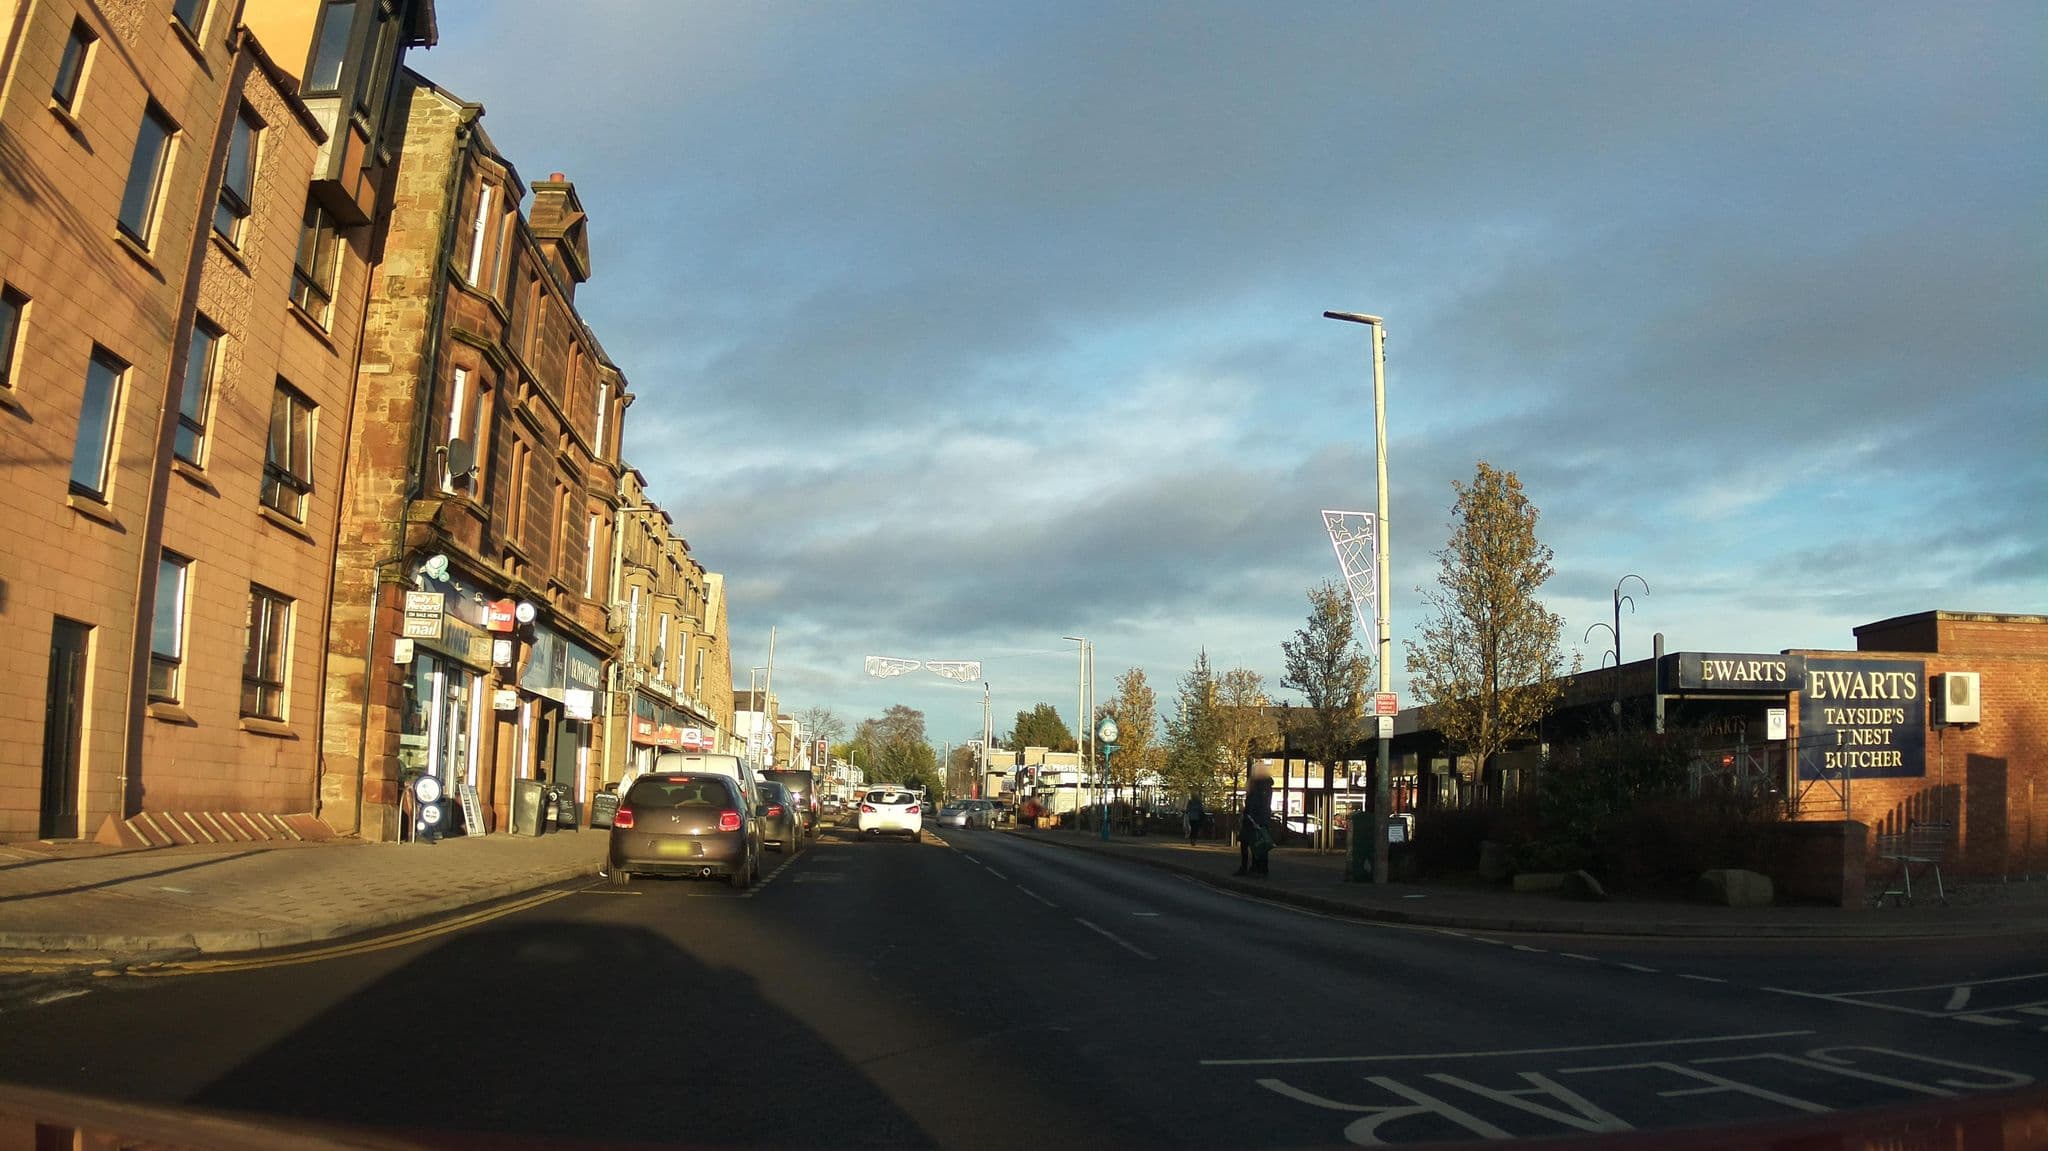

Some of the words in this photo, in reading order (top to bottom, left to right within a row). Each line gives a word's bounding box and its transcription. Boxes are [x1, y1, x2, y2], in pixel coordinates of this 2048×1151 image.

[408, 594, 430, 604] Daily
[408, 602, 440, 611] Record
[408, 621, 438, 636] mail
[1701, 660, 1786, 682] EWARTS
[1809, 670, 1917, 700] EWARTS
[1823, 708, 1905, 725] TAYSIDE'S
[1836, 728, 1893, 746] FNEST
[1825, 750, 1903, 769] BUTCHER
